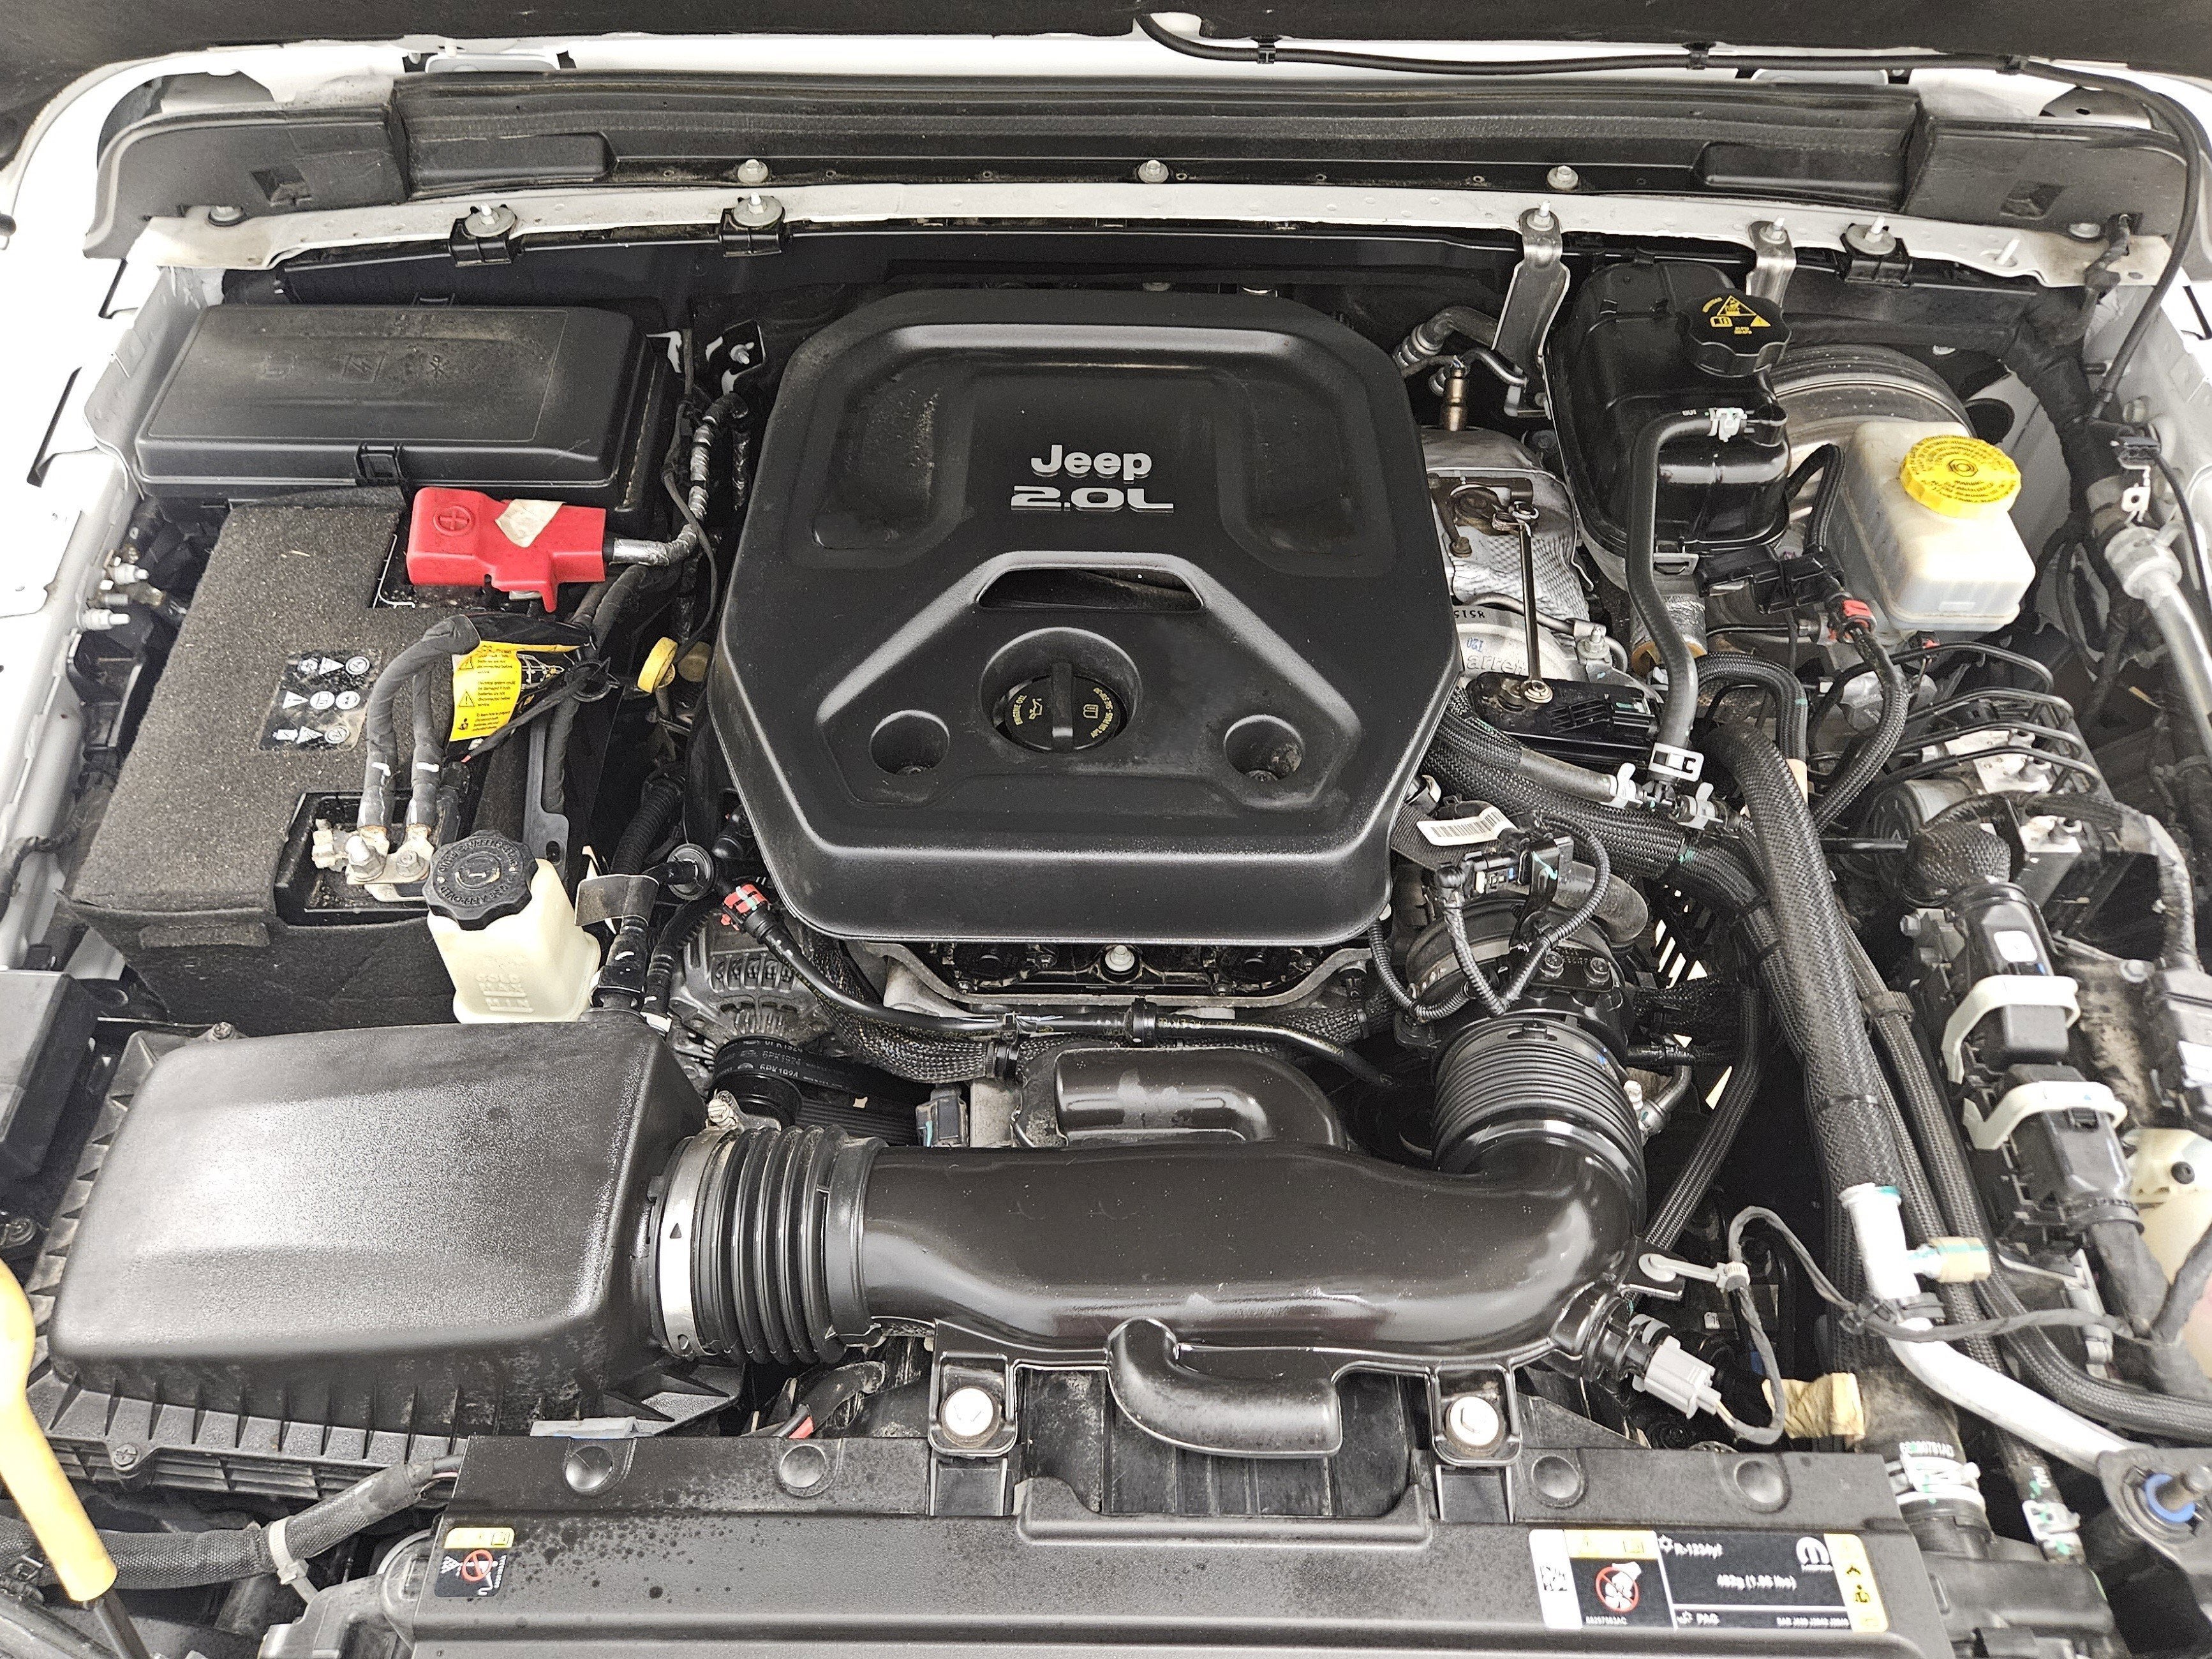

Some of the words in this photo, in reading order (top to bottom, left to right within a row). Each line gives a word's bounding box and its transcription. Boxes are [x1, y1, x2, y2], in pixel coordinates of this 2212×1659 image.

[1031, 445, 1152, 483] Jeep
[1011, 486, 1174, 512] 2.0L
[1016, 695, 1027, 704] OIL
[438, 849, 459, 874] FLUID
[762, 1050, 802, 1066] 6PK1924
